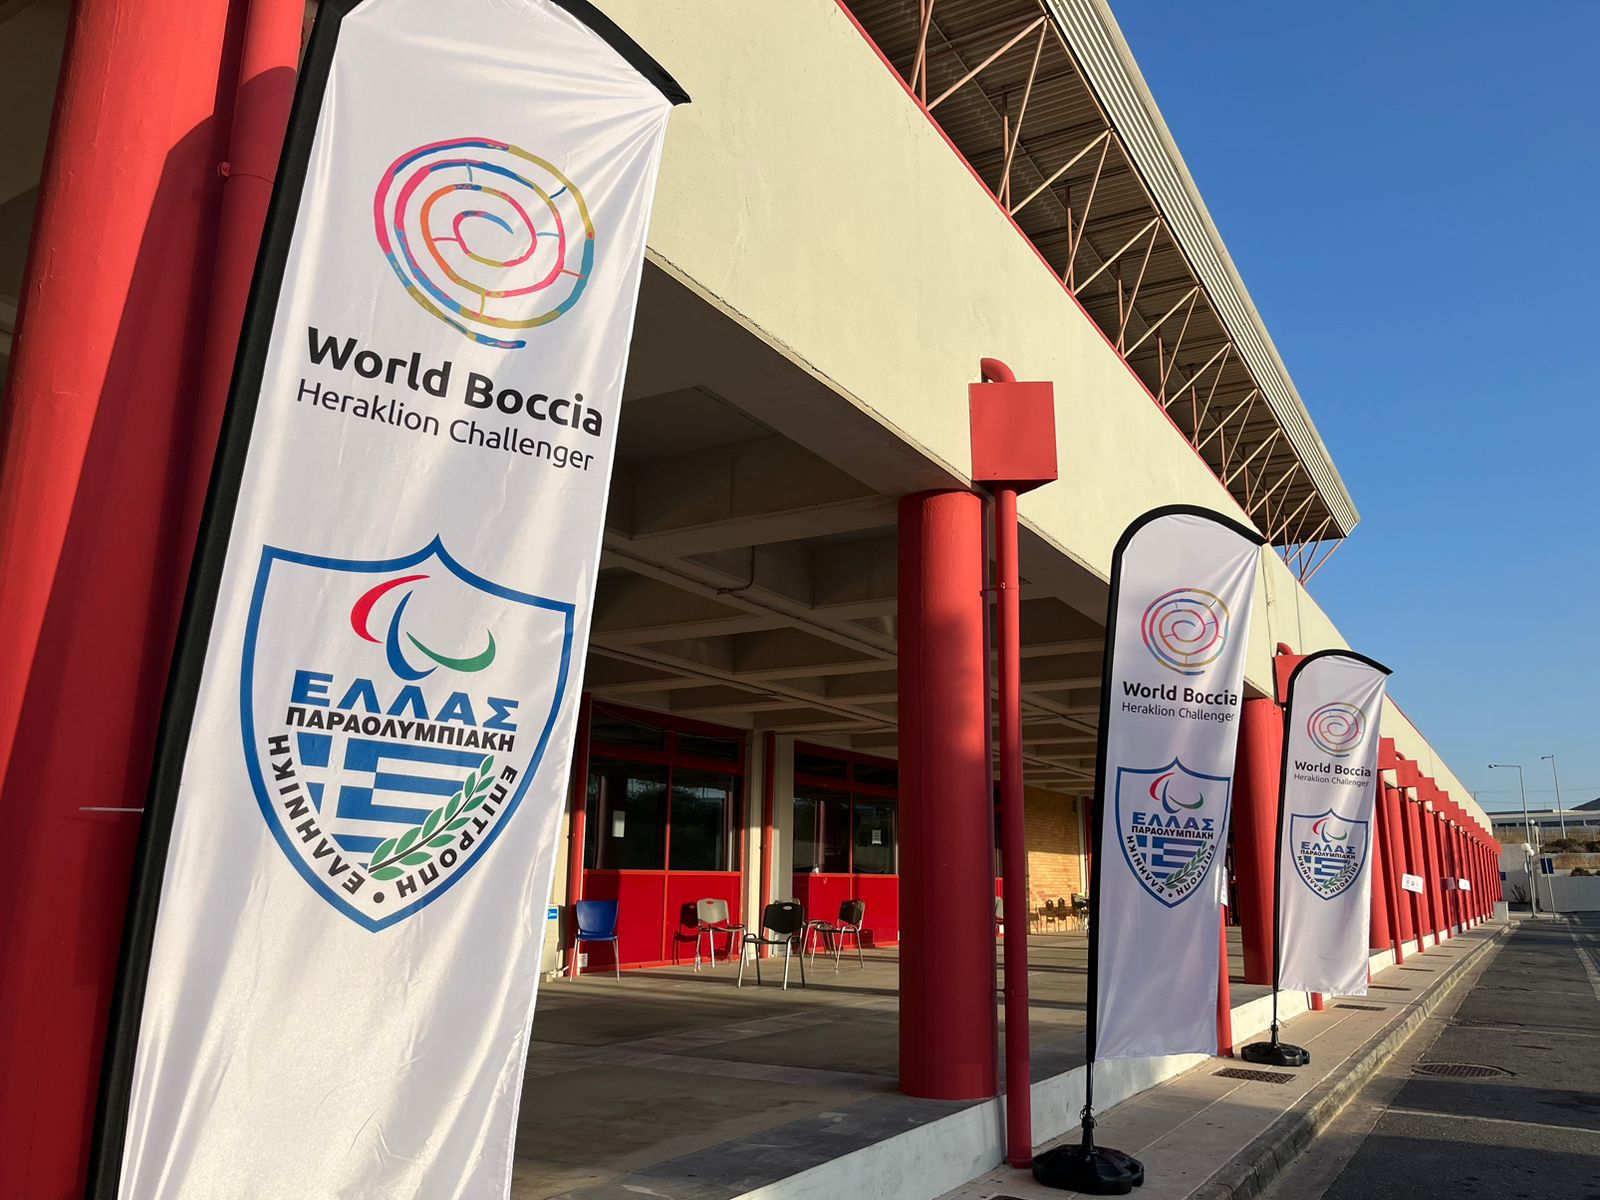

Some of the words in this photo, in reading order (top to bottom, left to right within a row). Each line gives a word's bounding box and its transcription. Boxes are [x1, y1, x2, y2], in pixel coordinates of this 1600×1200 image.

[308, 326, 452, 398] World
[464, 372, 603, 437] Boccia
[297, 378, 439, 436] Heraklion
[449, 418, 594, 471] Challenger
[290, 669, 519, 732] ΕΛΛΑΣ
[1123, 681, 1177, 701] World
[1183, 688, 1238, 706] Boccia
[1122, 701, 1175, 717] Heraklion
[1178, 707, 1235, 723] Challenger
[286, 706, 515, 752] ΠΑΡΑΟΛΥΜΠΙΑΚΗ
[1294, 773, 1330, 784] Heraklion
[1295, 760, 1331, 774] World
[1334, 764, 1371, 776] Boccia
[267, 734, 366, 895] ΕΛΛΗΝΙΚΗ
[395, 765, 518, 898] ΕΠΙΤΡΟΠΗ
[1132, 811, 1214, 831] ΕΛΛΑΣ
[1131, 825, 1214, 840] ΠΑΡΑΟΛΥΜΠΙΑΚΗ
[1301, 841, 1356, 854] ΕΛΛΑΣ
